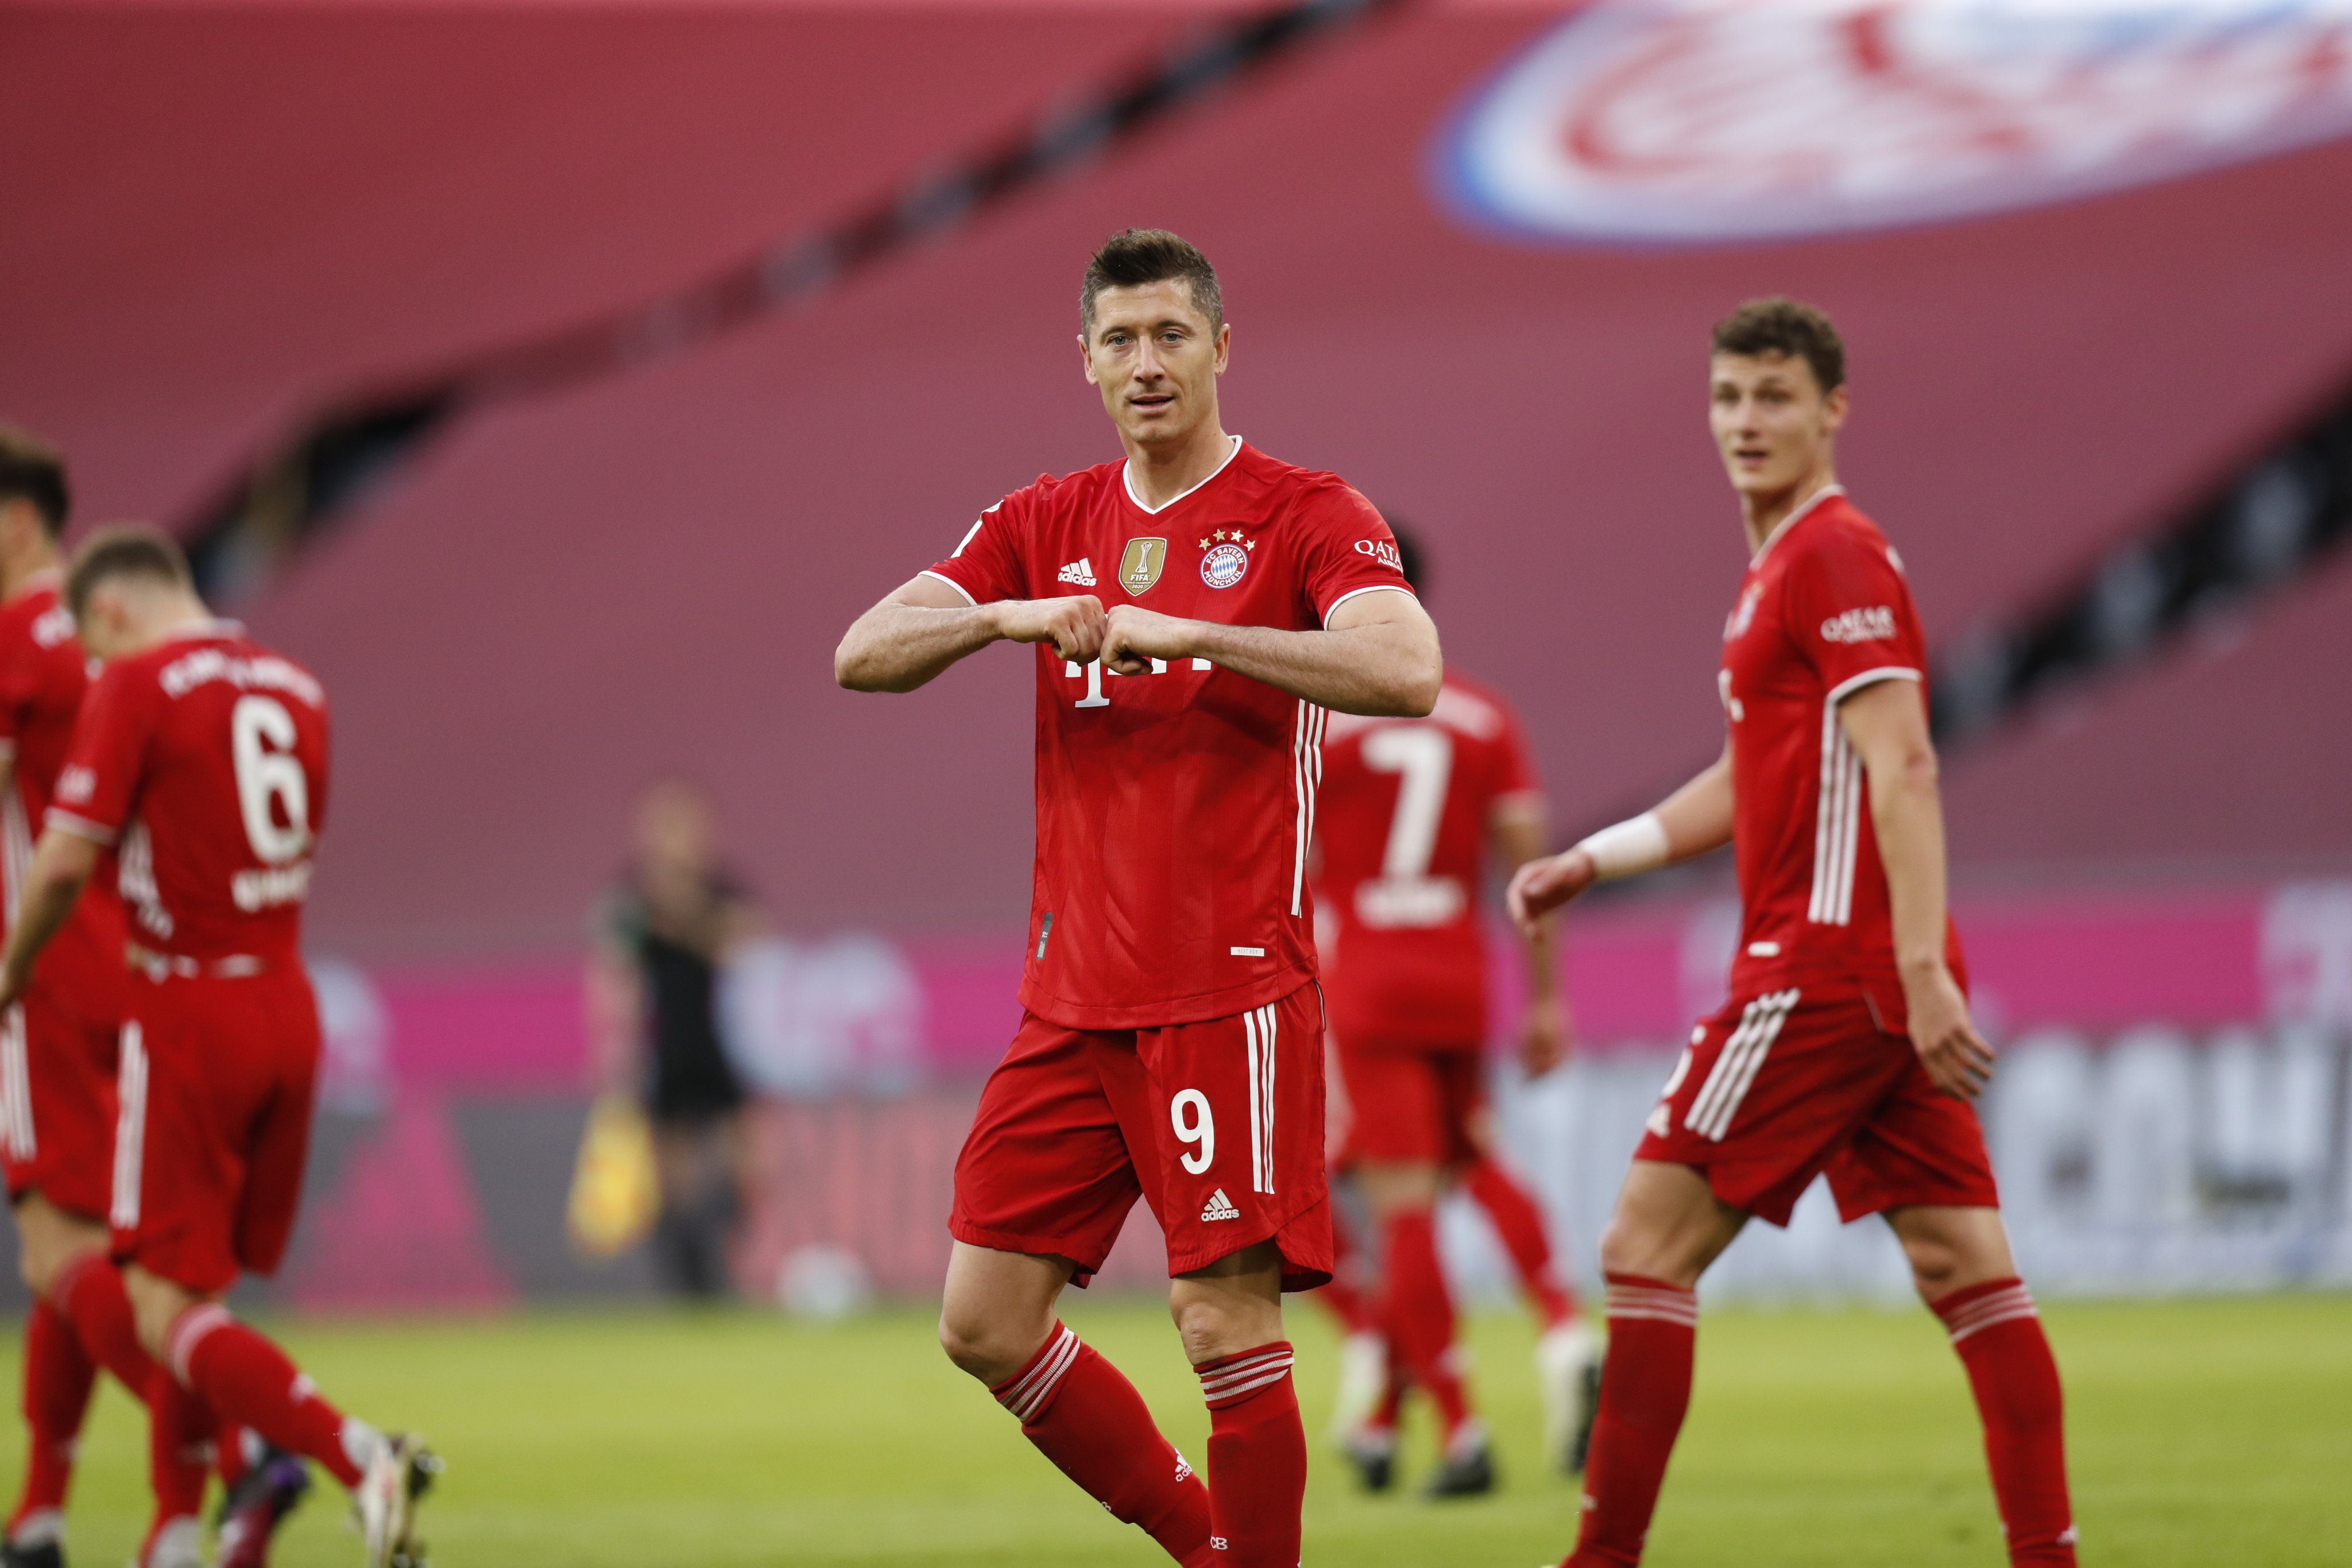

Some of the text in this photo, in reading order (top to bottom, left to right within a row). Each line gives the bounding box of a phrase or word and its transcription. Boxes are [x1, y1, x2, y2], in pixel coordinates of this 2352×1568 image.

[1206, 547, 1244, 564] FC BAYERN
[1354, 540, 1403, 573] QATA
[1058, 571, 1097, 586] adidas
[232, 694, 309, 863] 6
[1359, 729, 1454, 878] 7
[1171, 1088, 1215, 1175] 9
[1201, 1208, 1240, 1222] adidas
